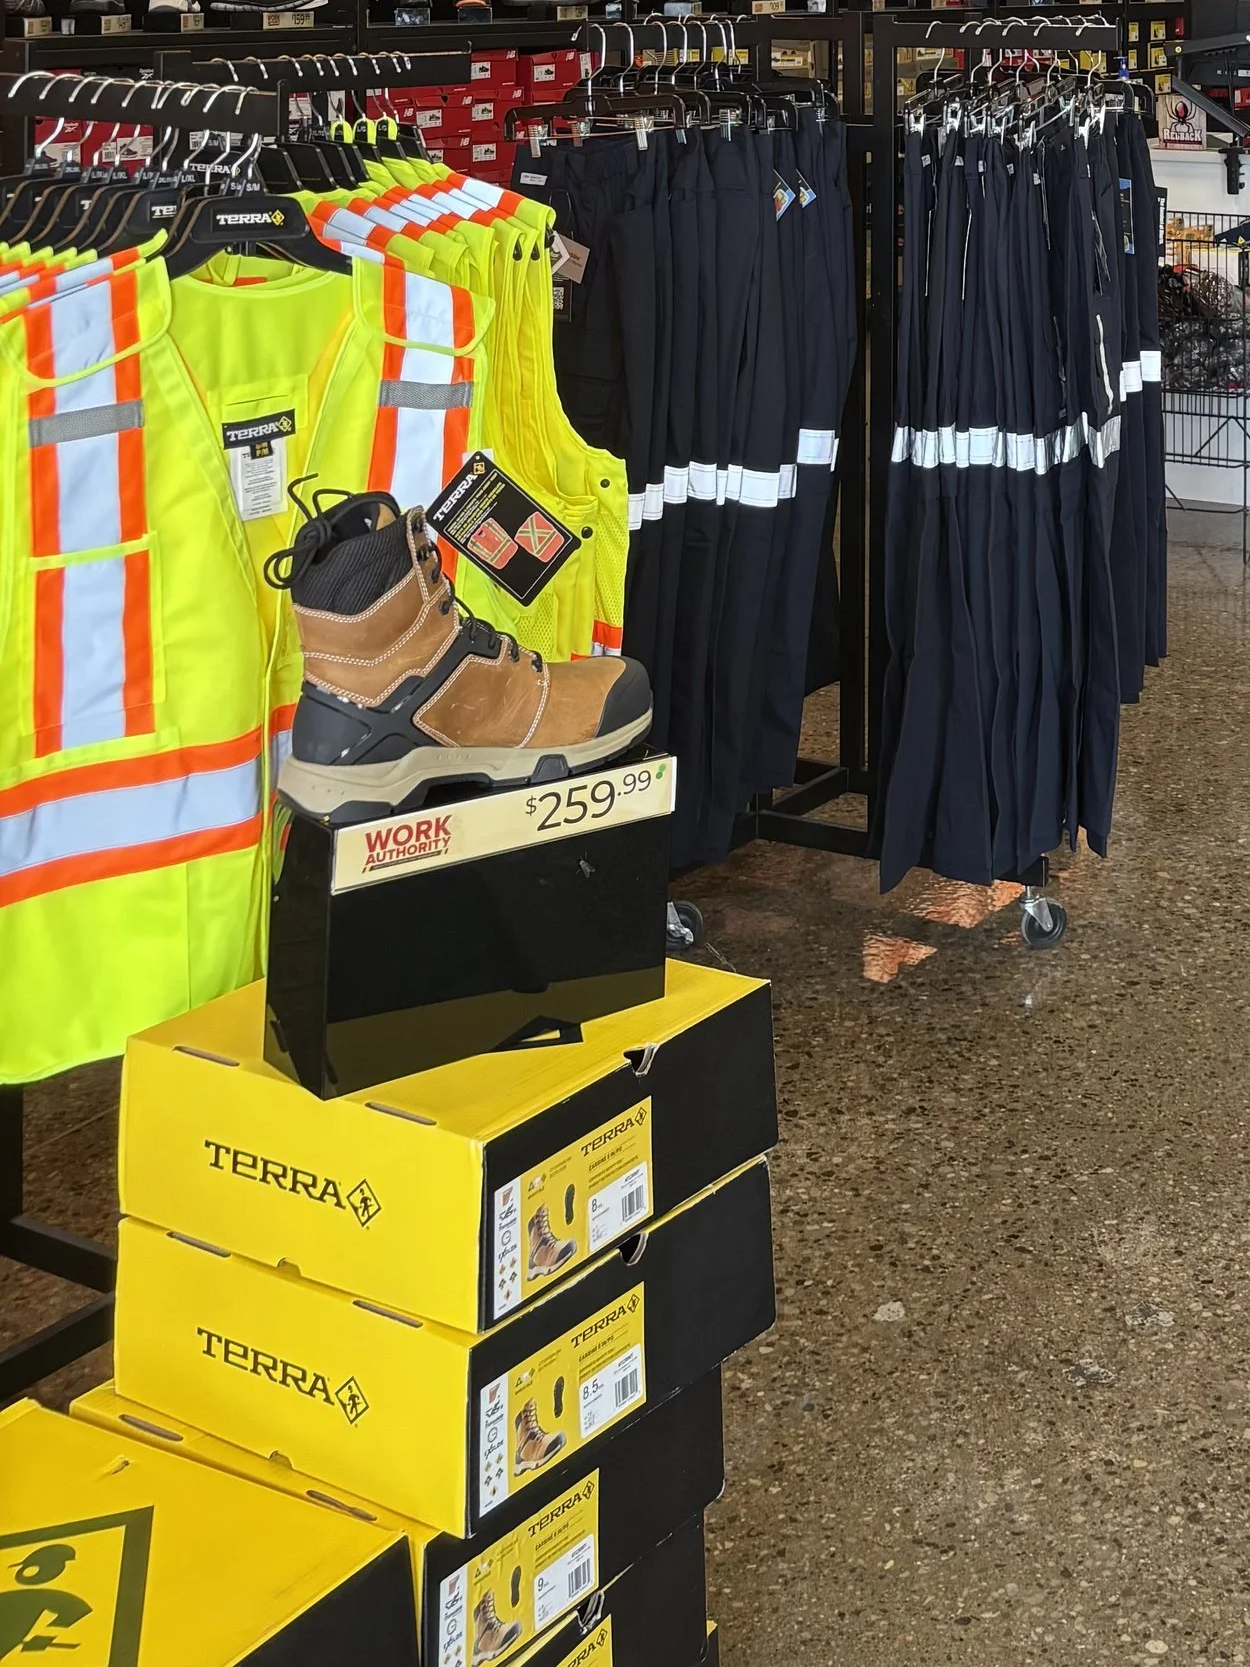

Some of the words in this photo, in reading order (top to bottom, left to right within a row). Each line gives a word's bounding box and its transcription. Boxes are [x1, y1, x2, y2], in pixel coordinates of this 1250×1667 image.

[1164, 128, 1202, 142] REDBACK
[246, 182, 260, 192] S/M
[216, 211, 272, 224] TERRA
[226, 421, 280, 442] TERRA
[432, 472, 478, 522] TERRA
[364, 814, 454, 854] WORK
[526, 770, 652, 832] $259.99
[364, 836, 451, 866] AUTHORITY
[580, 1117, 636, 1158] TERRA
[204, 1138, 346, 1210] TERRA
[592, 1198, 598, 1212] 8
[570, 1306, 627, 1349] TERRA
[196, 1326, 336, 1406] TERRA
[583, 1379, 599, 1400] 8.5
[528, 1492, 583, 1538] TERRA
[538, 1577, 544, 1592] 9
